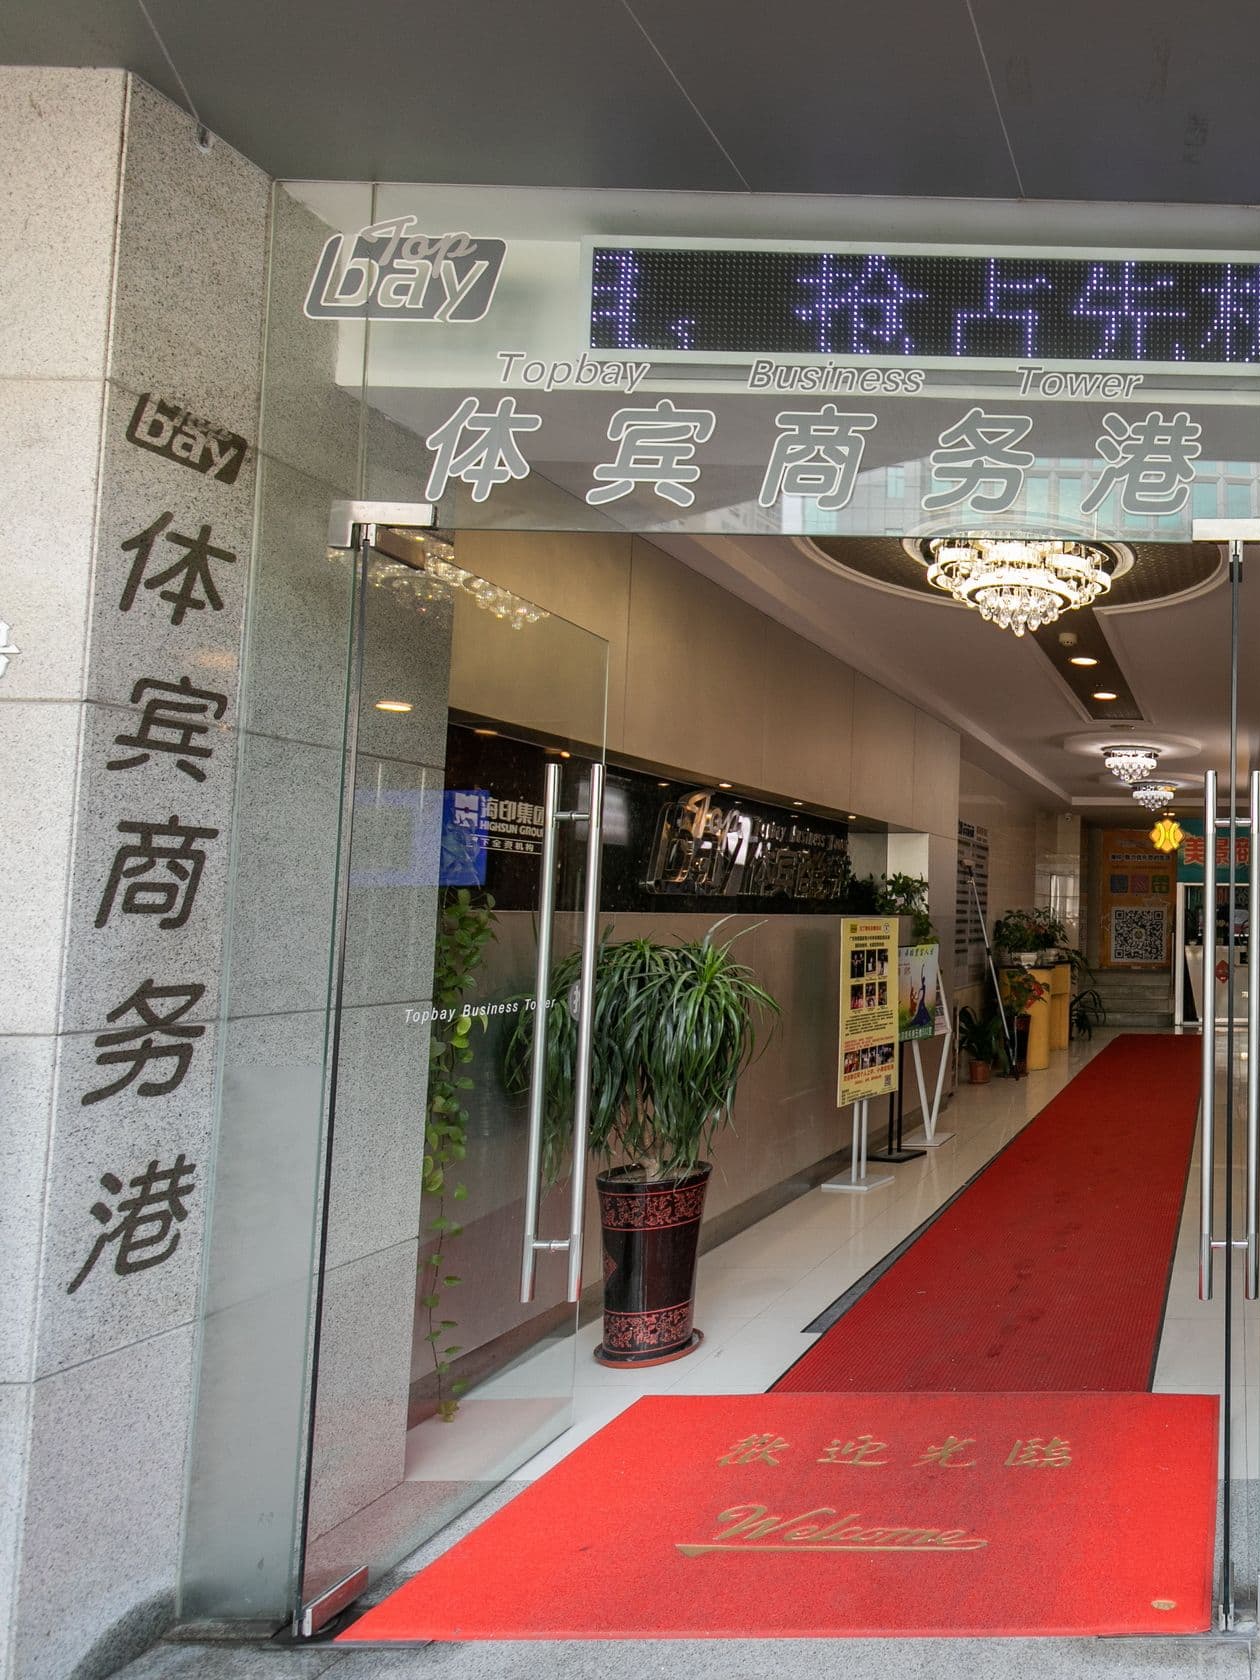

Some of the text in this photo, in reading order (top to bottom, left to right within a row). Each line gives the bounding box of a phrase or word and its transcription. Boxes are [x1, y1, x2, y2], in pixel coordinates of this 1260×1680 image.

[359, 214, 478, 280] Top
[318, 233, 490, 322] bay
[496, 351, 1145, 400] Topbay Business Tower
[424, 395, 1203, 516] 体宾商务港
[480, 796, 544, 827] 海印集团
[480, 820, 544, 838] HIGHSUN GROU
[66, 510, 237, 1296] 体宾商务港
[405, 1007, 456, 1025] Topbay
[462, 1000, 519, 1018] Business
[524, 998, 557, 1012] Toer
[712, 1503, 988, 1550] Welcome
